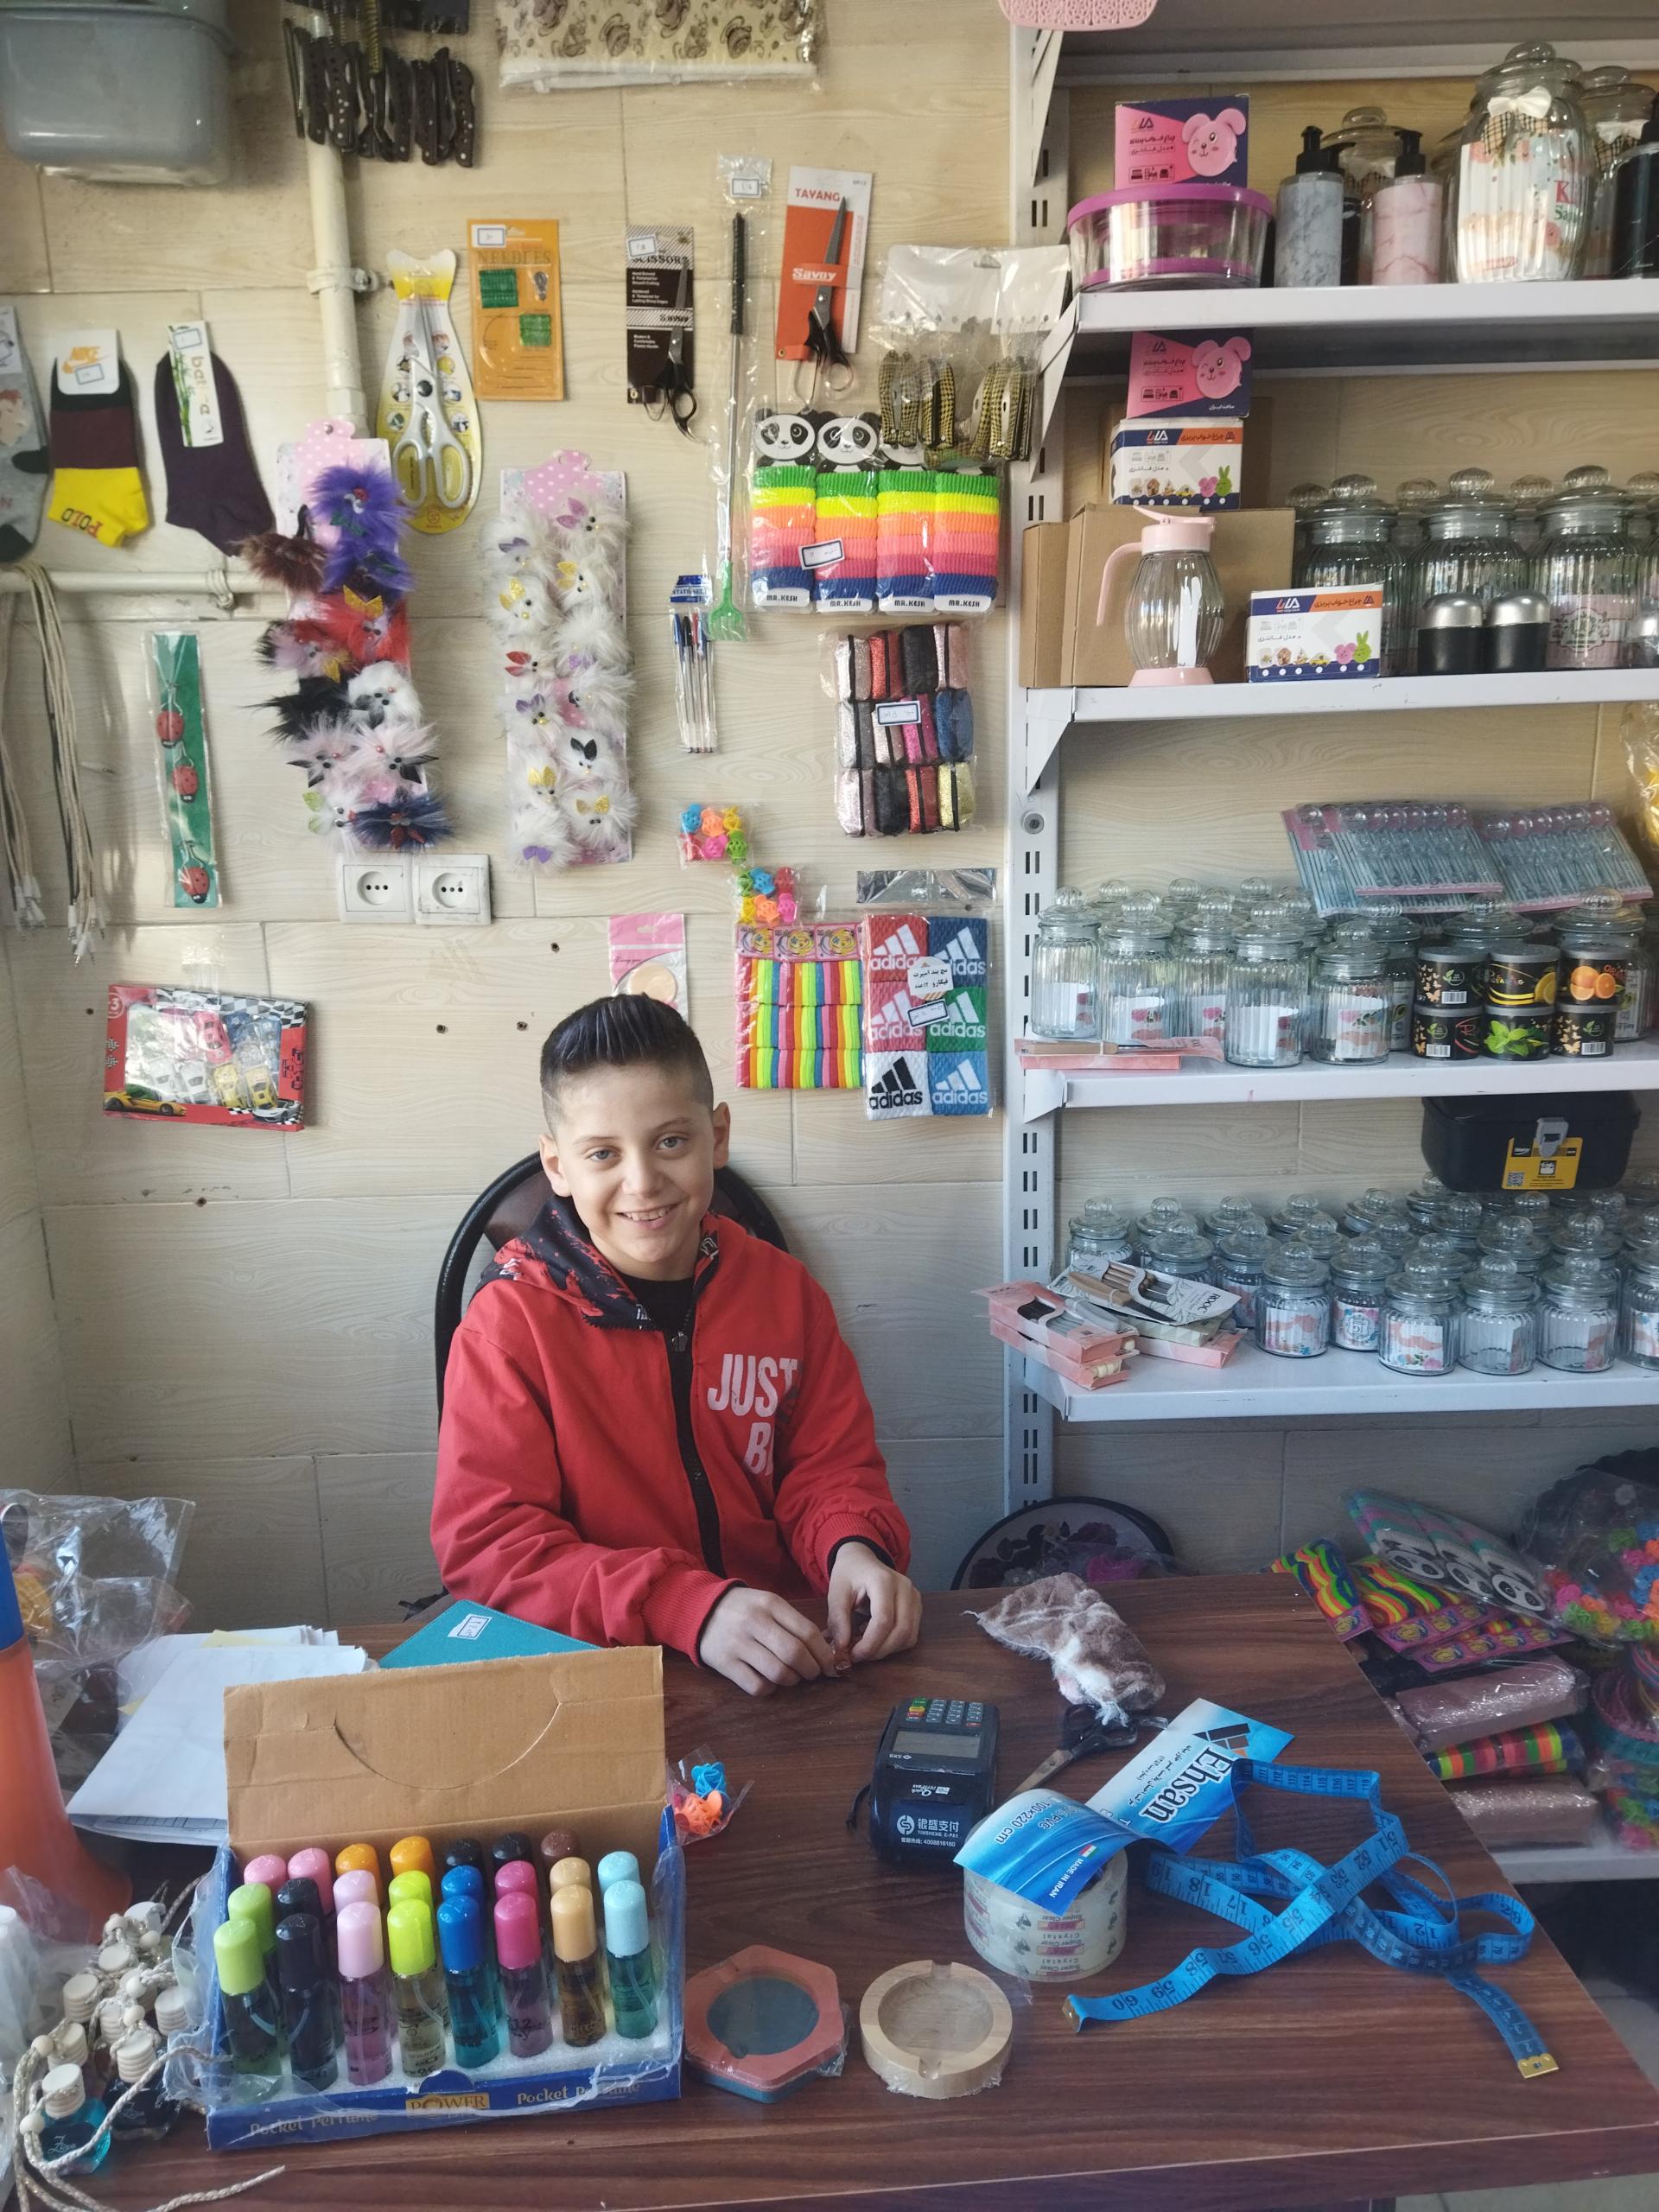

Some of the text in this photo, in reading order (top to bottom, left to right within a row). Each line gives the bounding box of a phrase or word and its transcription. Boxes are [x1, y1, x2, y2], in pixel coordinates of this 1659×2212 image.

[60, 507, 104, 538] POLO
[930, 1020, 986, 1038] adidas
[869, 1090, 923, 1110] adidas
[932, 1090, 988, 1105] adidas
[707, 1353, 798, 1418] JUST
[1139, 1746, 1234, 1823] Ehsan
[918, 1818, 959, 1833] 银盛支付
[1039, 1813, 1062, 1829] PVC
[995, 1827, 1014, 1844] cm
[1069, 1858, 1084, 1875] MADE
[1305, 1871, 1315, 1881] 93
[1049, 1879, 1065, 1898] IRAN
[1189, 1878, 1211, 1896] 18
[1227, 1895, 1247, 1916] 17
[1500, 1903, 1521, 1923] 28
[1282, 1908, 1304, 1932] 55
[1414, 1922, 1440, 1940] 12
[1248, 1935, 1272, 1955] 56
[1185, 1953, 1209, 1976] 58
[1218, 1951, 1237, 1964] 57
[1151, 1980, 1175, 1999] 59
[1112, 1995, 1138, 2011] 60
[410, 2094, 486, 2112] POWER
[517, 2087, 569, 2103] Pocket
[250, 2118, 303, 2136] Pocket
